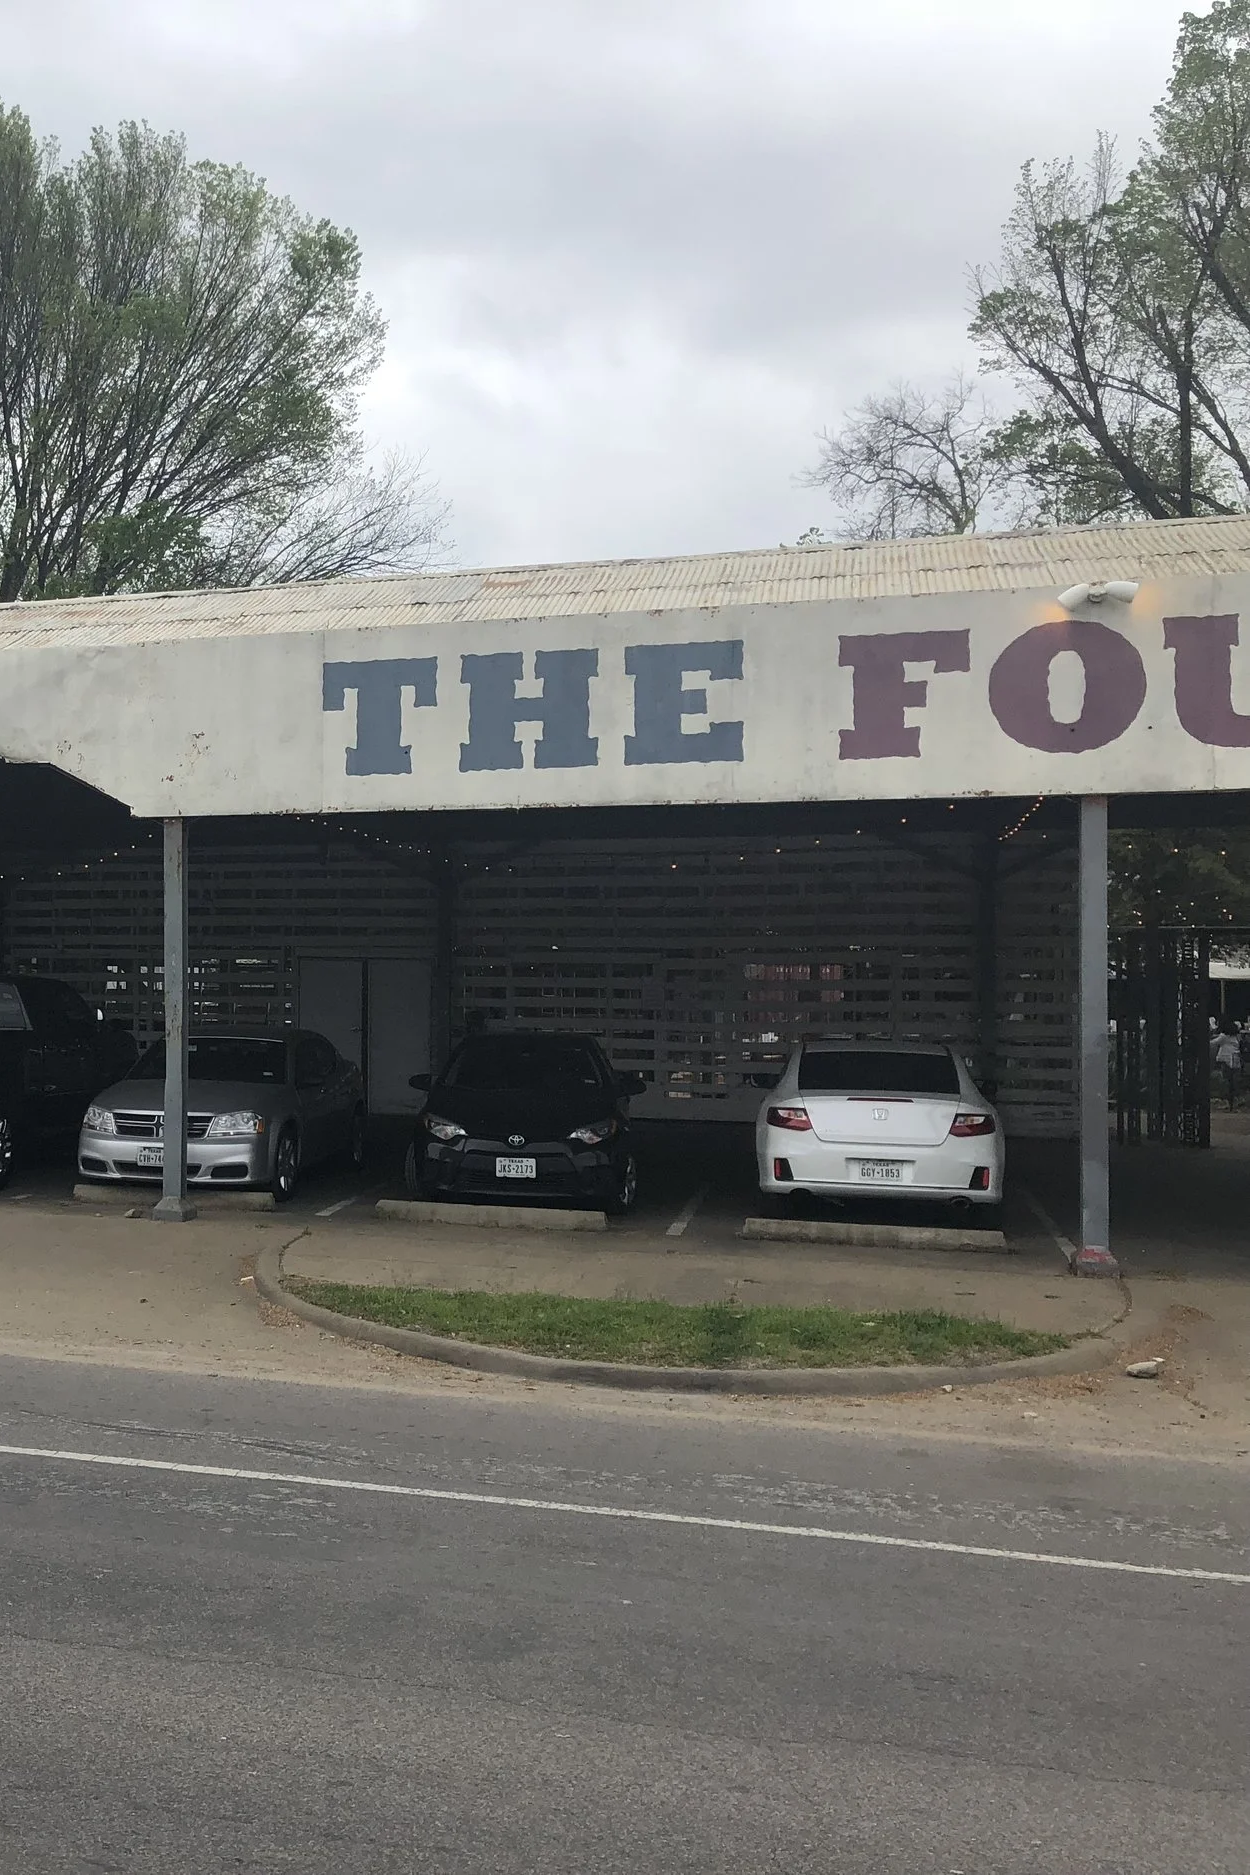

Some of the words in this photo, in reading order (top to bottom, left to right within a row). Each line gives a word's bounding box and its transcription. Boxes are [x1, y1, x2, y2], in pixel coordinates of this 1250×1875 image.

[322, 639, 744, 776] THE
[138, 1153, 164, 1163] CVH-74
[498, 1164, 534, 1174] JKS-2173
